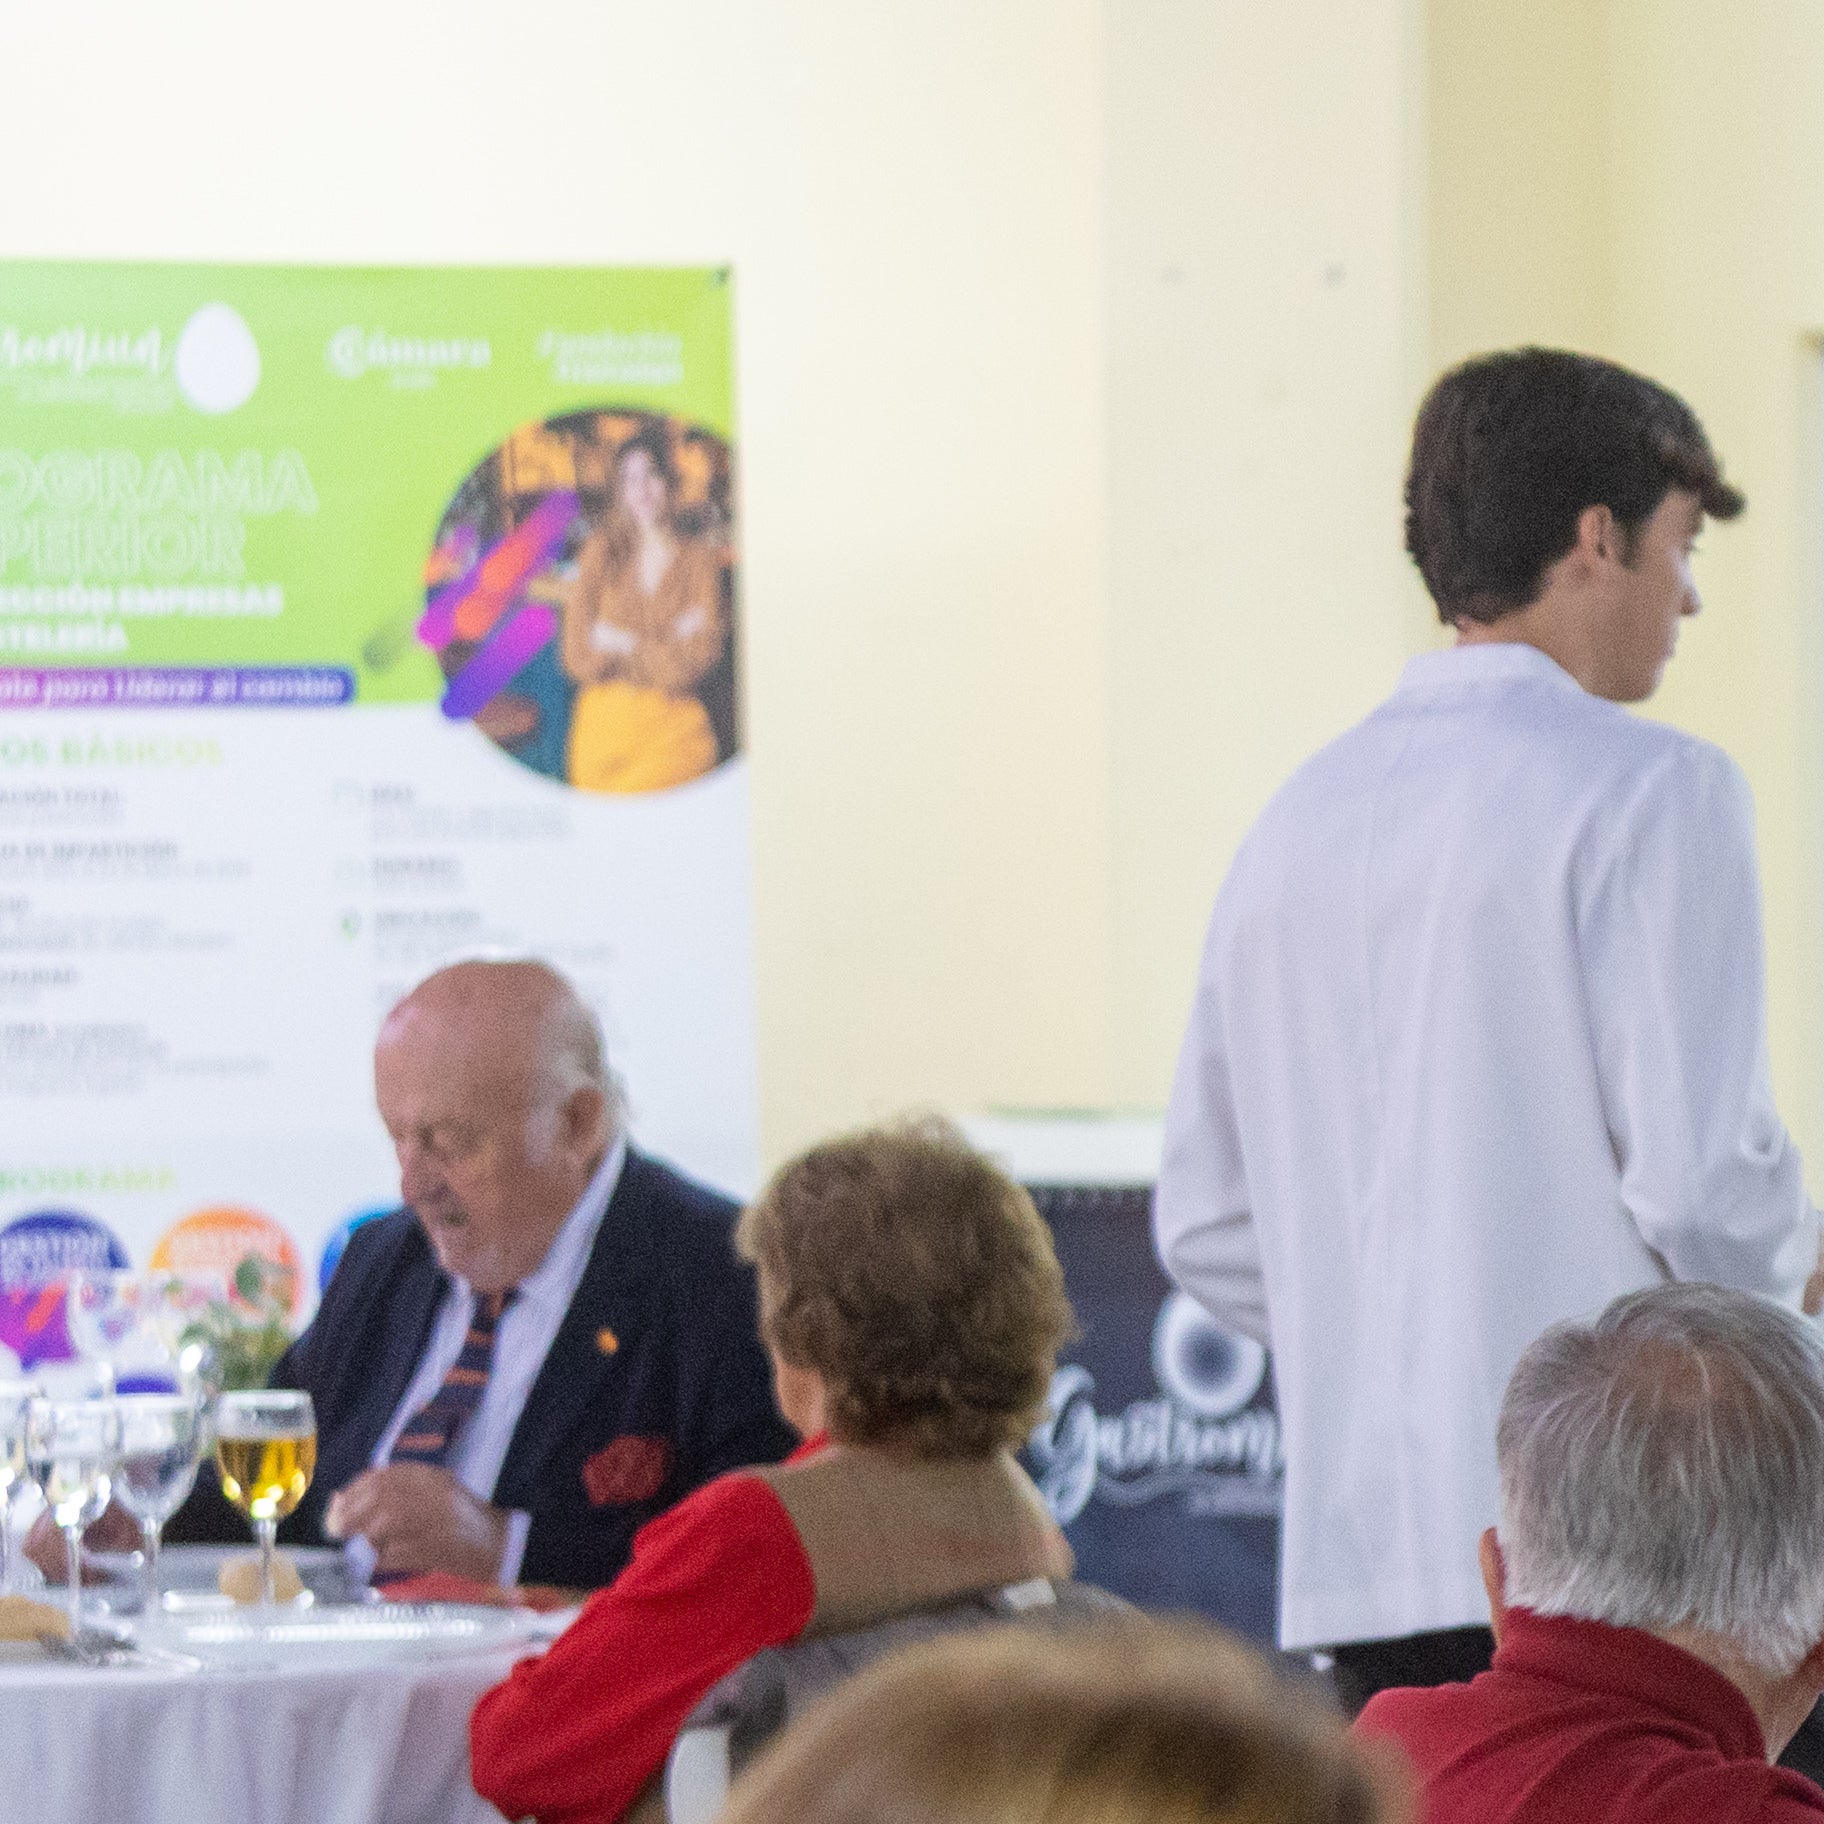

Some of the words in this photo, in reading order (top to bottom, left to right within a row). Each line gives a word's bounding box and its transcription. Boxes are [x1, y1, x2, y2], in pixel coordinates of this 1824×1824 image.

[324, 325, 493, 378] Cámara
[118, 584, 284, 617] EMPRESAS
[59, 733, 223, 765] BÁSICOS
